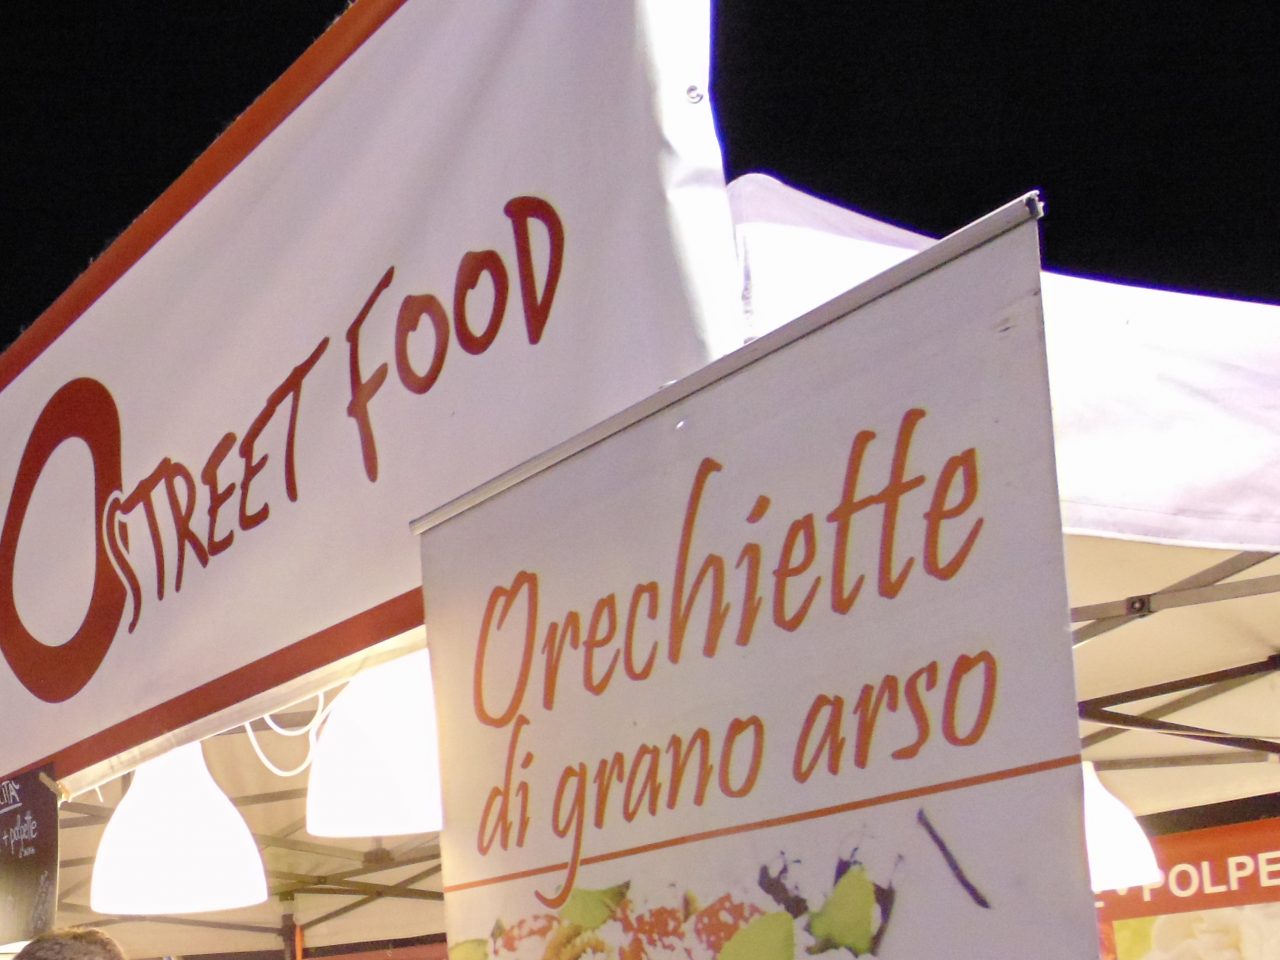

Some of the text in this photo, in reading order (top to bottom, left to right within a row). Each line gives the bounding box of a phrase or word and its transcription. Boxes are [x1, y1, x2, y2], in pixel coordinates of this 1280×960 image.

[103, 336, 330, 634] STREET
[346, 195, 565, 483] FOOD
[473, 408, 985, 729] Orechiette
[478, 650, 998, 908] di grano arso
